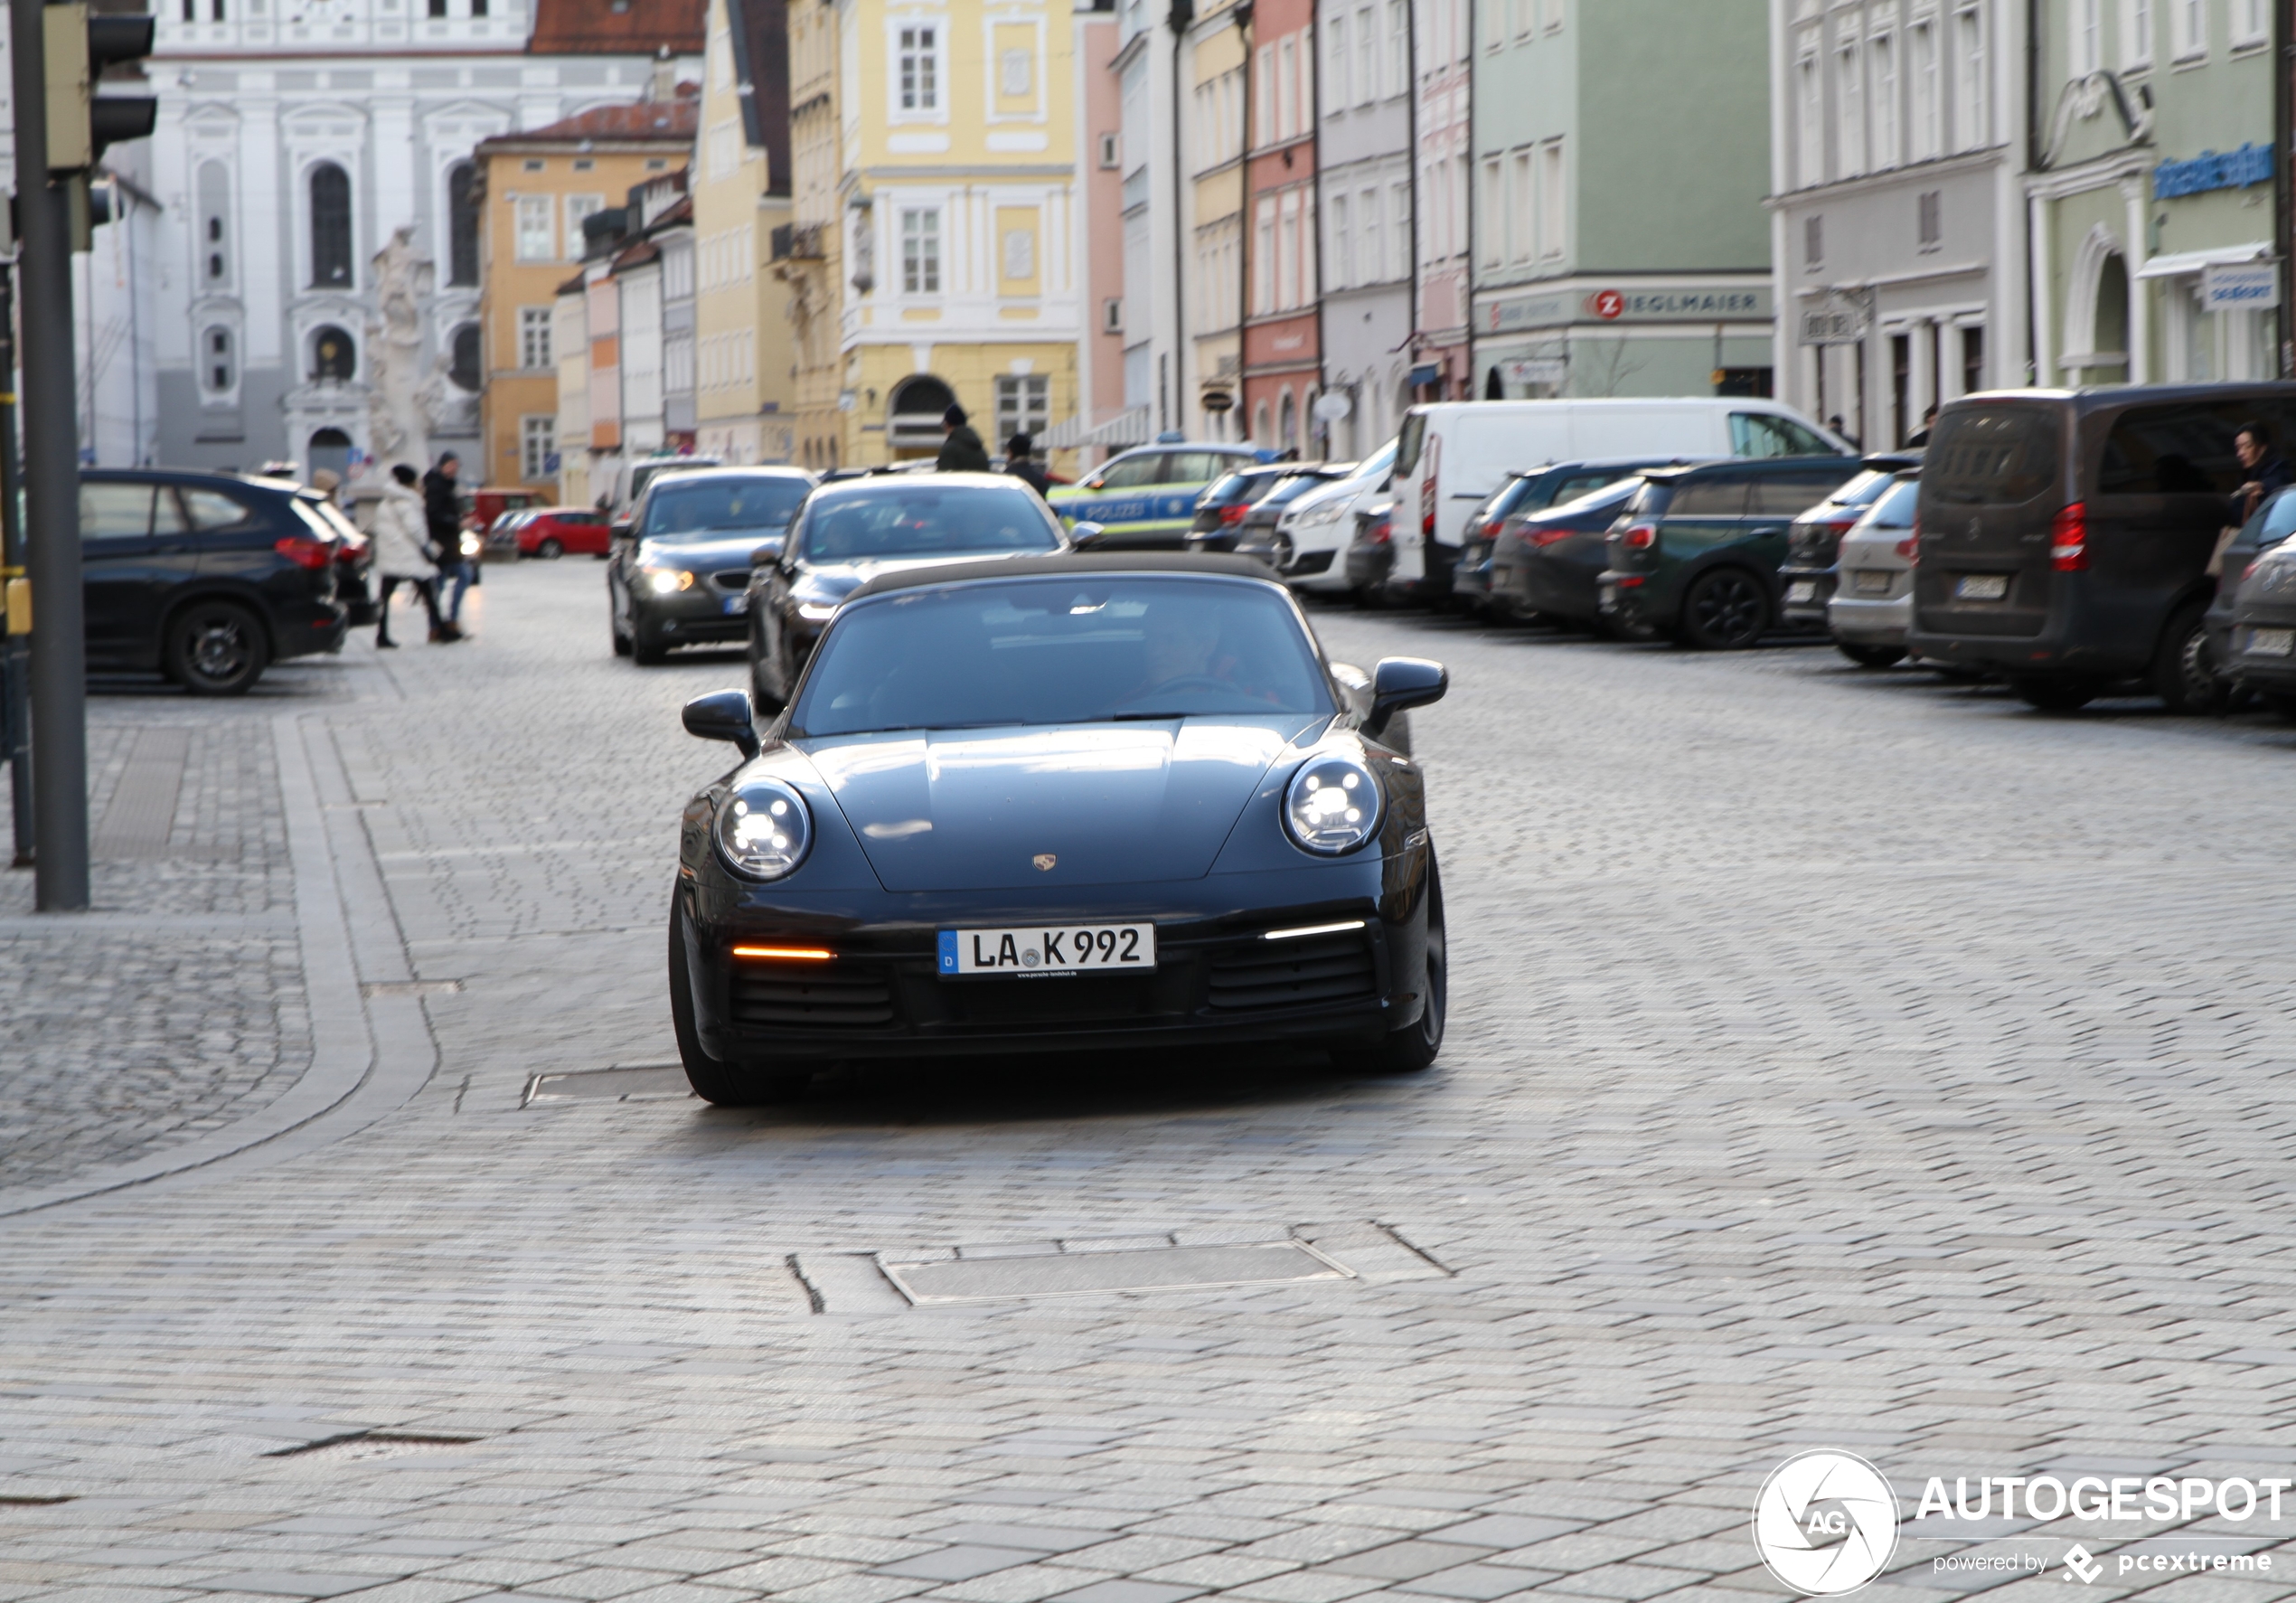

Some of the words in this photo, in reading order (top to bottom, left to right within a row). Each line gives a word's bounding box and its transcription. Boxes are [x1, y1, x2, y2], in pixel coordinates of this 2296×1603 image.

[1593, 288, 1756, 319] ZIEGLMAIER
[1086, 503, 1144, 520] POLIZEI
[974, 934, 1019, 967] LA
[1044, 931, 1066, 965] K
[1074, 929, 1140, 963] 992
[945, 956, 953, 967] D
